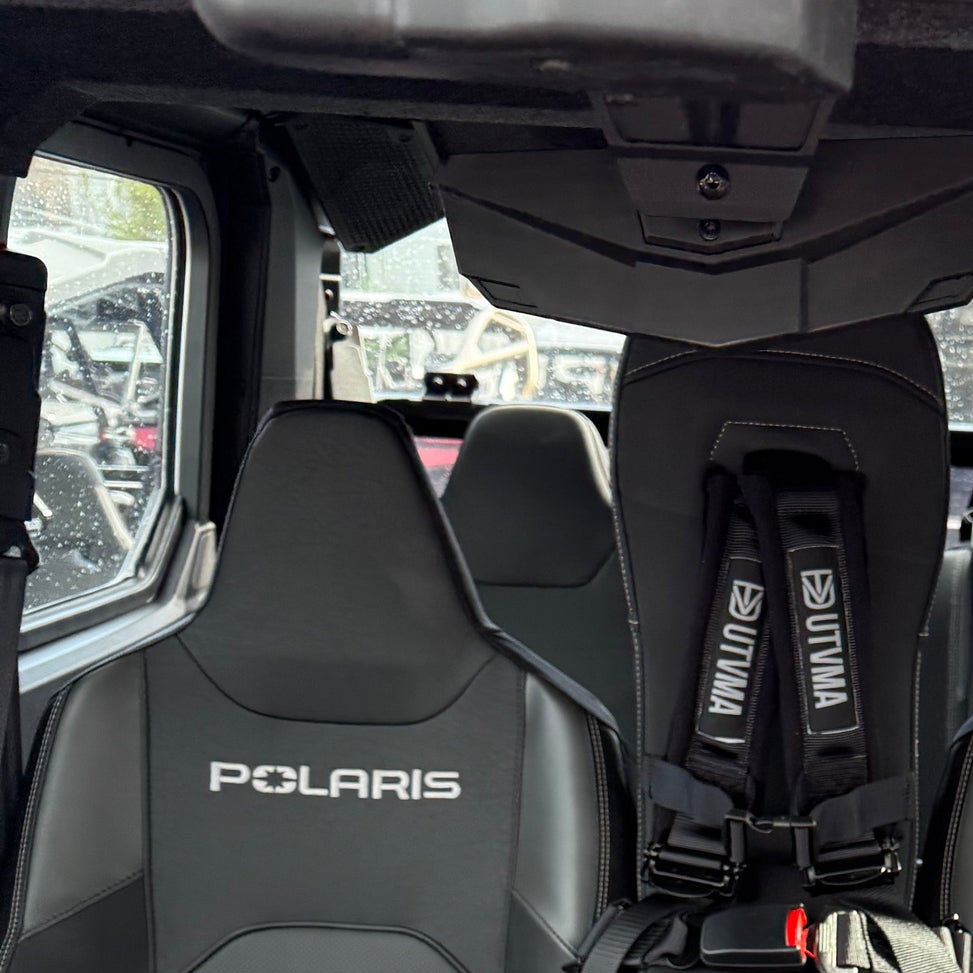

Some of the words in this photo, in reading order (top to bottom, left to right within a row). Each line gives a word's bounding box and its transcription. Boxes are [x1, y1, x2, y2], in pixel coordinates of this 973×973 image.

[708, 623, 758, 716] UTVMA
[805, 613, 848, 709] UTVMA
[209, 761, 462, 801] POLARIS
